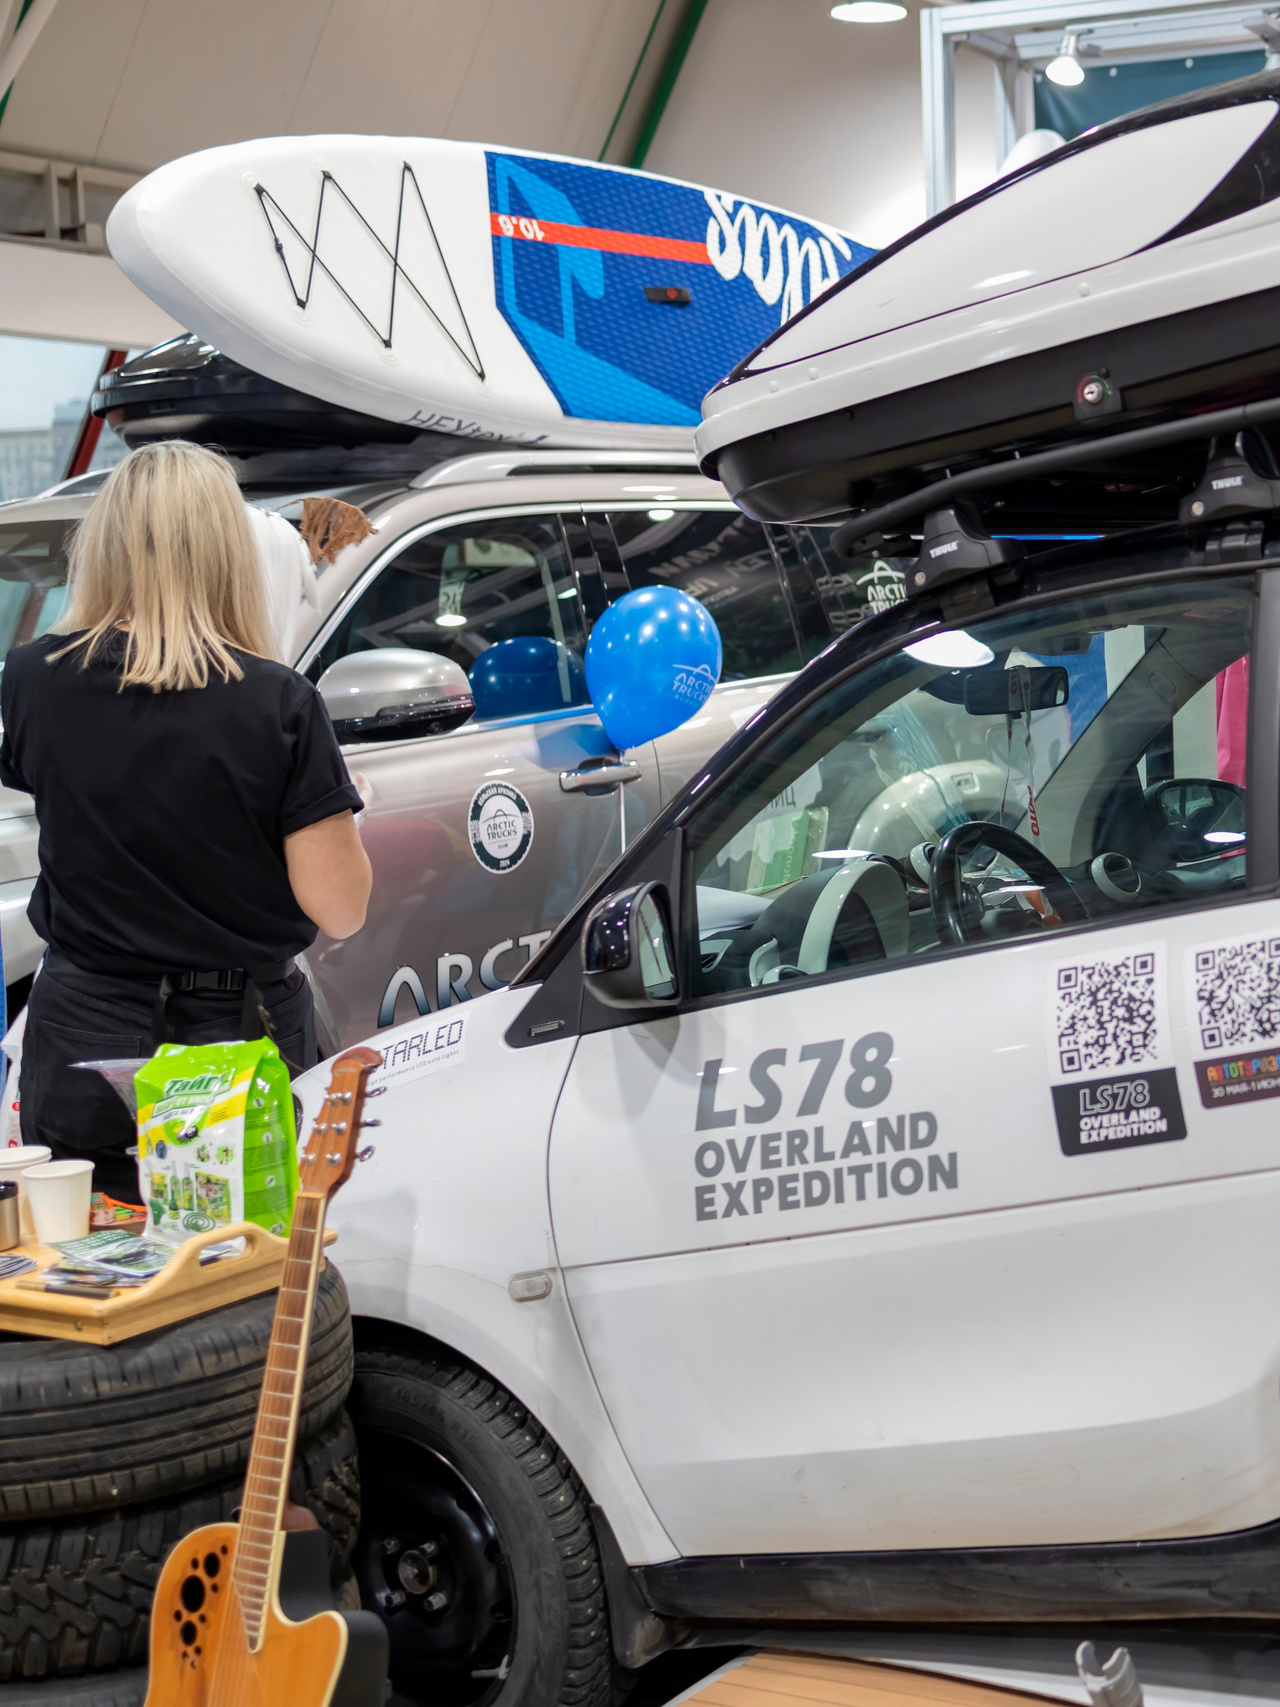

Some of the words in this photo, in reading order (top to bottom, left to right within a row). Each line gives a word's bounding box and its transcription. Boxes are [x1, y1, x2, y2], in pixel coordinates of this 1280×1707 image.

[498, 213, 546, 242] 10.6
[1211, 474, 1244, 490] THULE
[928, 540, 959, 558] THULE
[867, 583, 907, 602] ARCTI
[486, 819, 516, 832] ARCTIC
[487, 829, 518, 840] TRUCKS
[530, 1021, 560, 1036] passion
[416, 1060, 427, 1070] LED
[695, 1031, 895, 1132] LS78
[1079, 1079, 1151, 1116] LS78
[1211, 1086, 1225, 1099] 30
[1079, 1107, 1161, 1131] OVERLAND
[1079, 1118, 1168, 1145] EXPEDITION
[694, 1111, 939, 1178] OVERLAND
[694, 1151, 959, 1222] EXPEDITION
